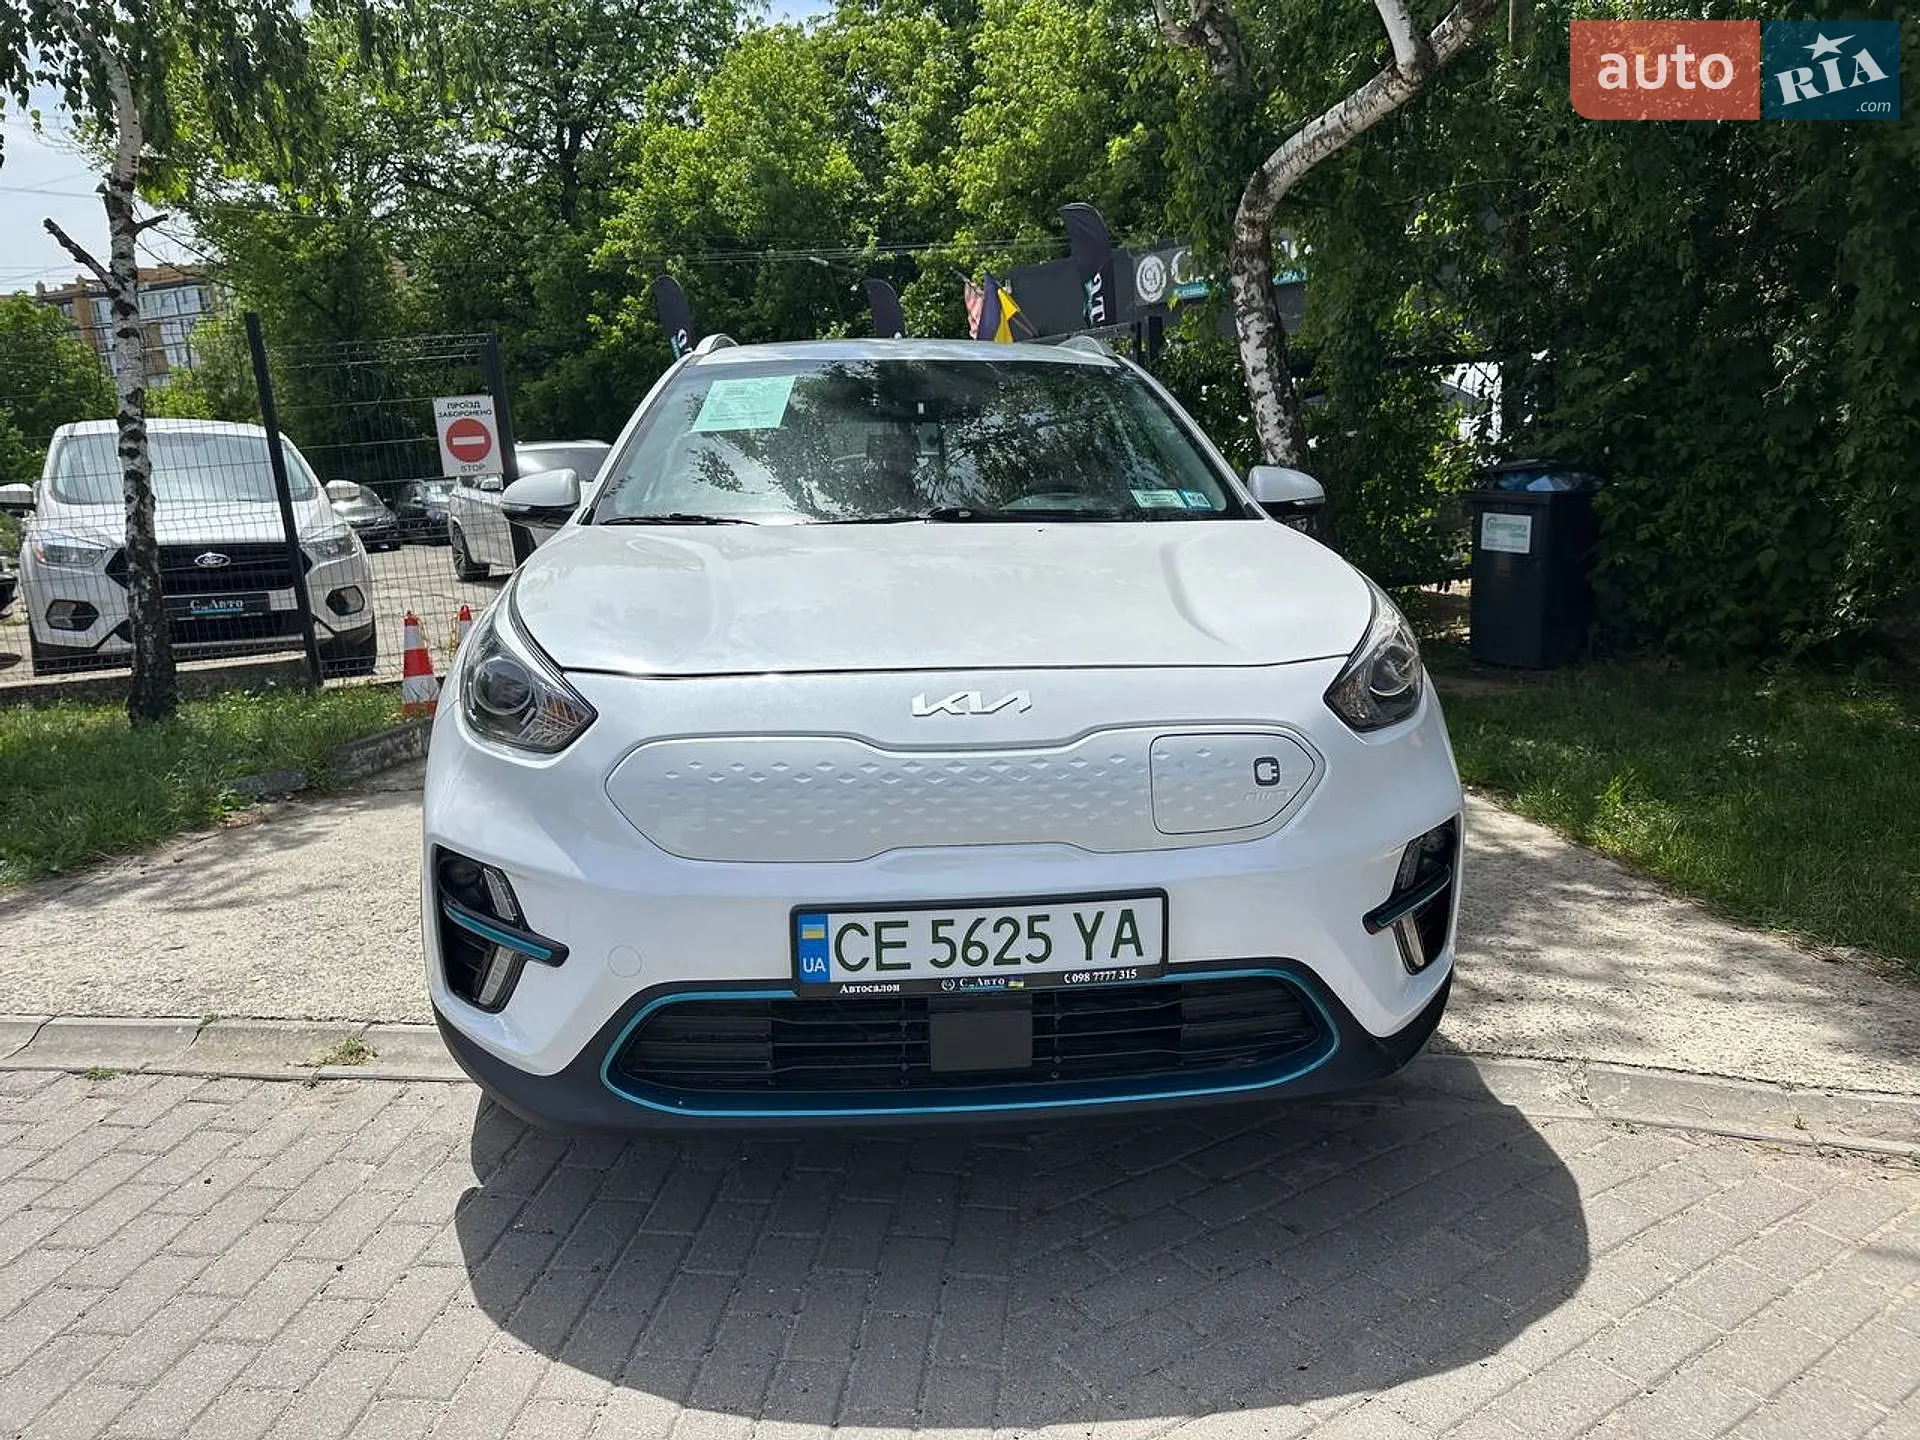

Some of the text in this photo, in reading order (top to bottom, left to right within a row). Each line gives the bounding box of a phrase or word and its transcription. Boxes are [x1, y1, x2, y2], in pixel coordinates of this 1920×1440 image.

[460, 464, 486, 472] STOP
[911, 690, 1033, 717] KIA
[834, 909, 1144, 972] CE 5625 YA
[802, 956, 826, 973] UA
[1071, 968, 1138, 984] 098 7777 315
[840, 983, 900, 994] Автосалон
